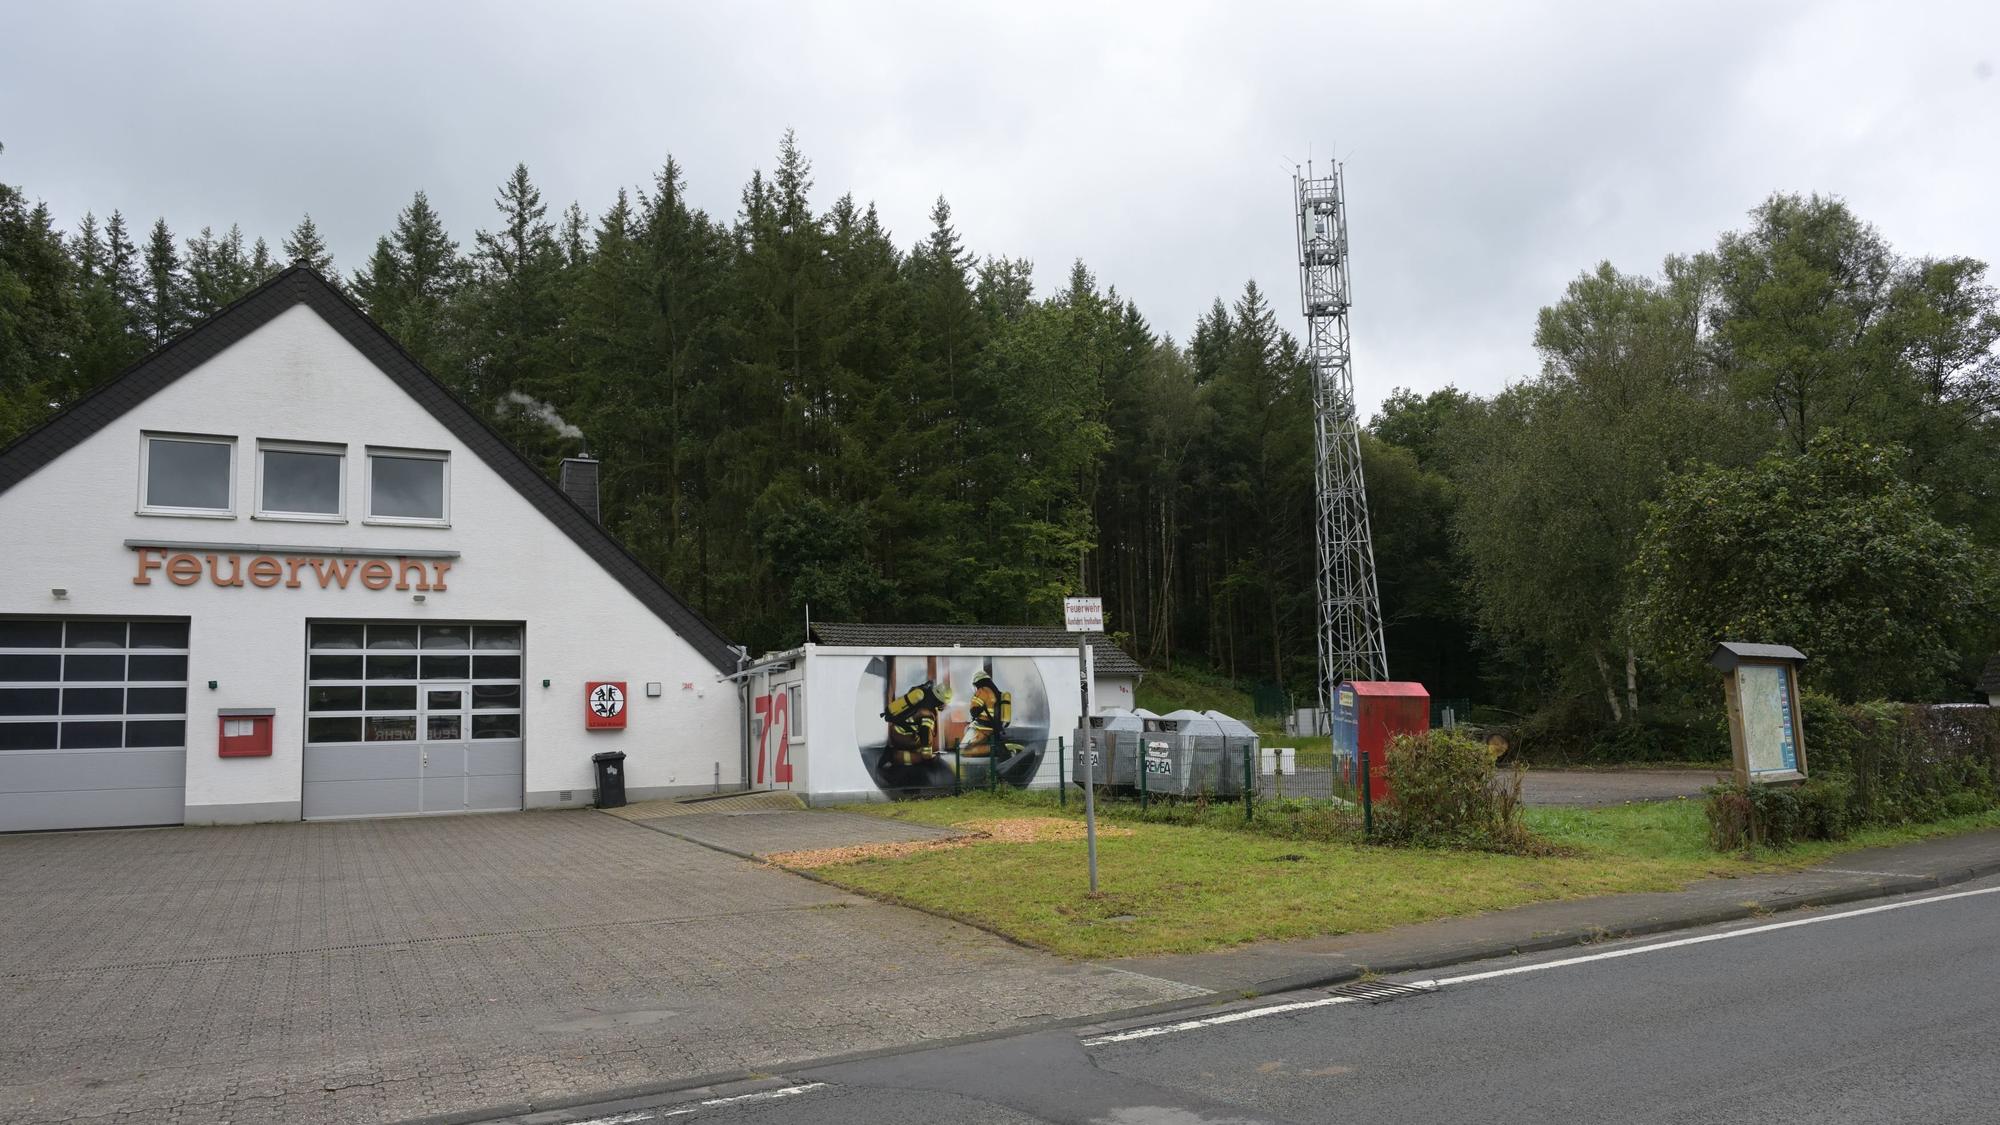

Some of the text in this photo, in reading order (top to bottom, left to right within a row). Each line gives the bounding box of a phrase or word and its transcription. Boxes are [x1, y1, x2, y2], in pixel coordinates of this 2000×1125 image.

[133, 549, 450, 591] Feuerwehr
[1066, 602, 1102, 613] Feuerwehr
[755, 692, 793, 784] 72
